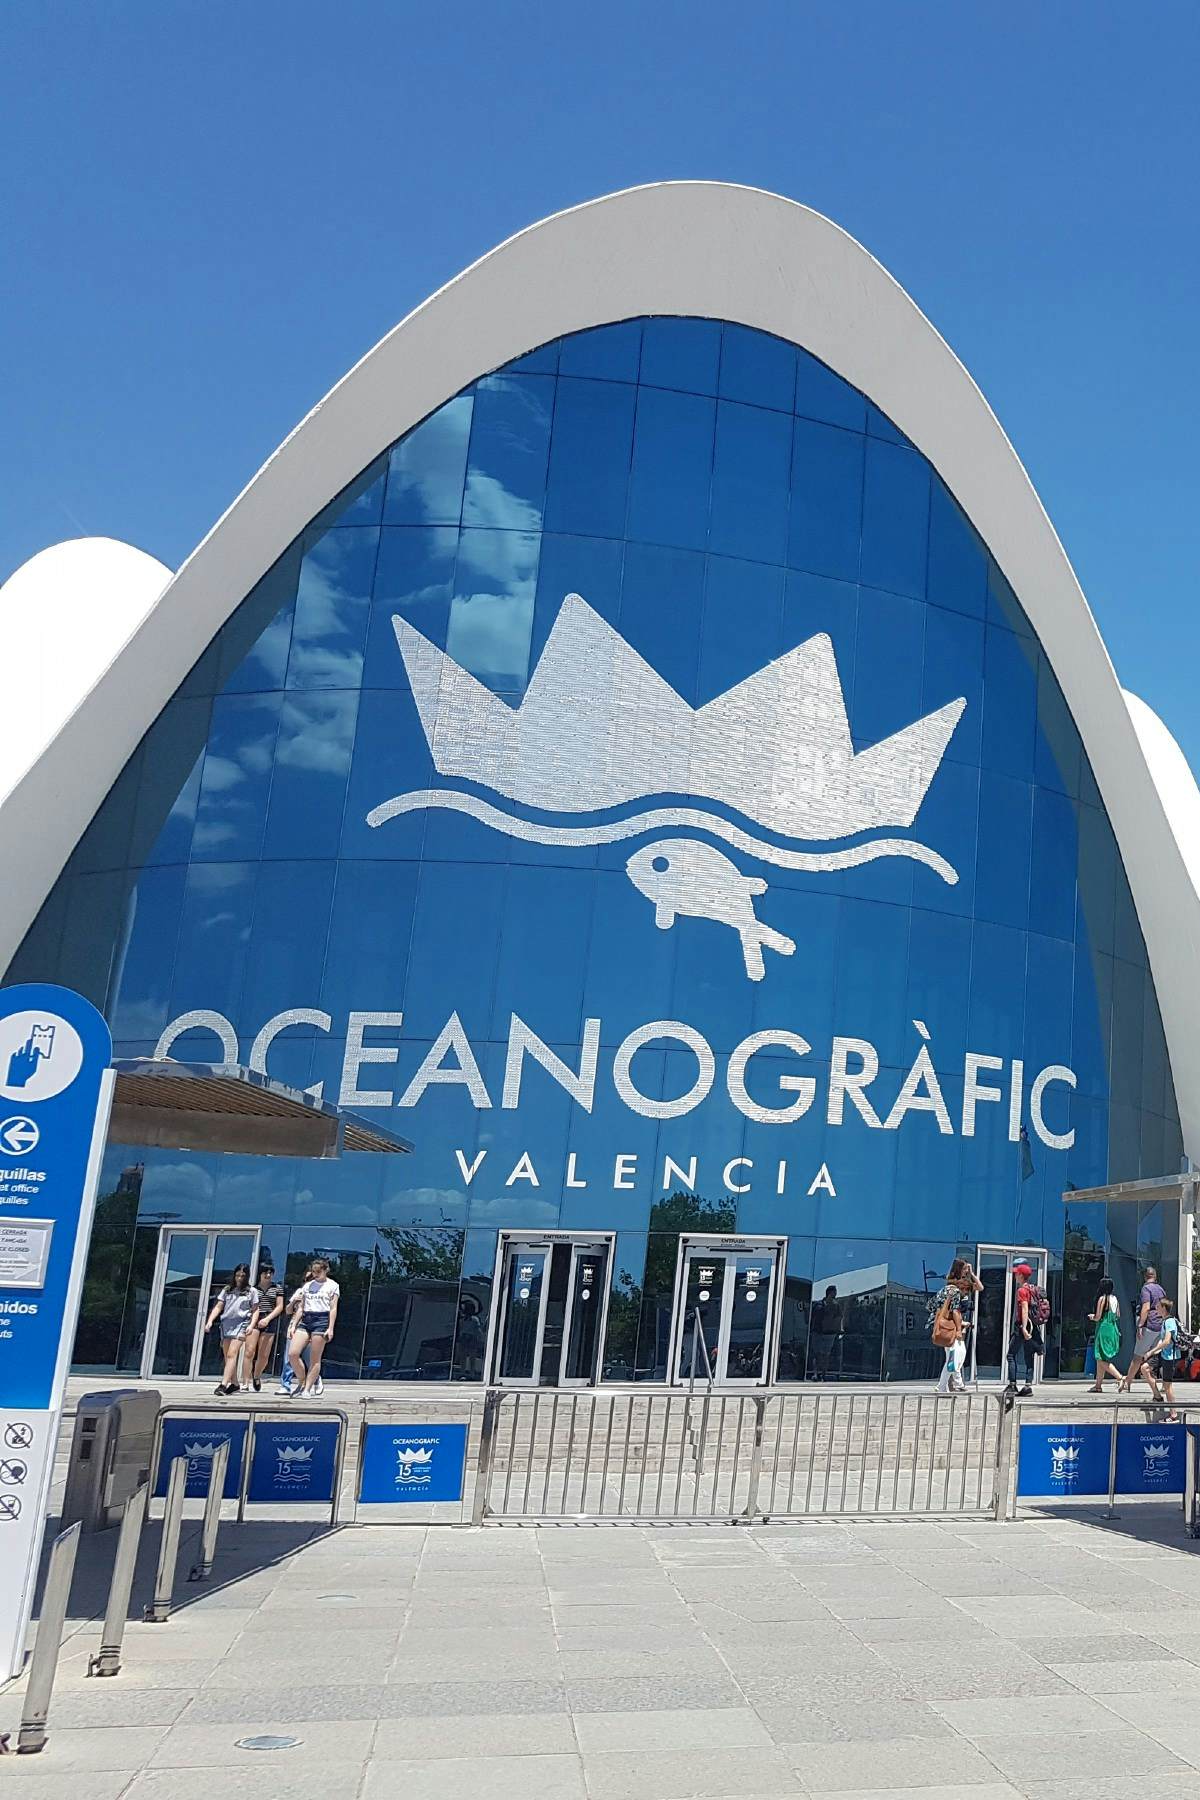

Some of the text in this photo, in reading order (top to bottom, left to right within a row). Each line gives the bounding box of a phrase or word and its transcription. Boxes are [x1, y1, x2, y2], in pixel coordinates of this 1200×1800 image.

[456, 1150, 836, 1197] VALENCIA
[11, 1184, 40, 1193] office
[189, 1459, 198, 1470] 5
[278, 1462, 291, 1474] 15
[399, 1464, 411, 1476] 15
[1052, 1460, 1063, 1472] 15
[1145, 1459, 1155, 1469] 15
